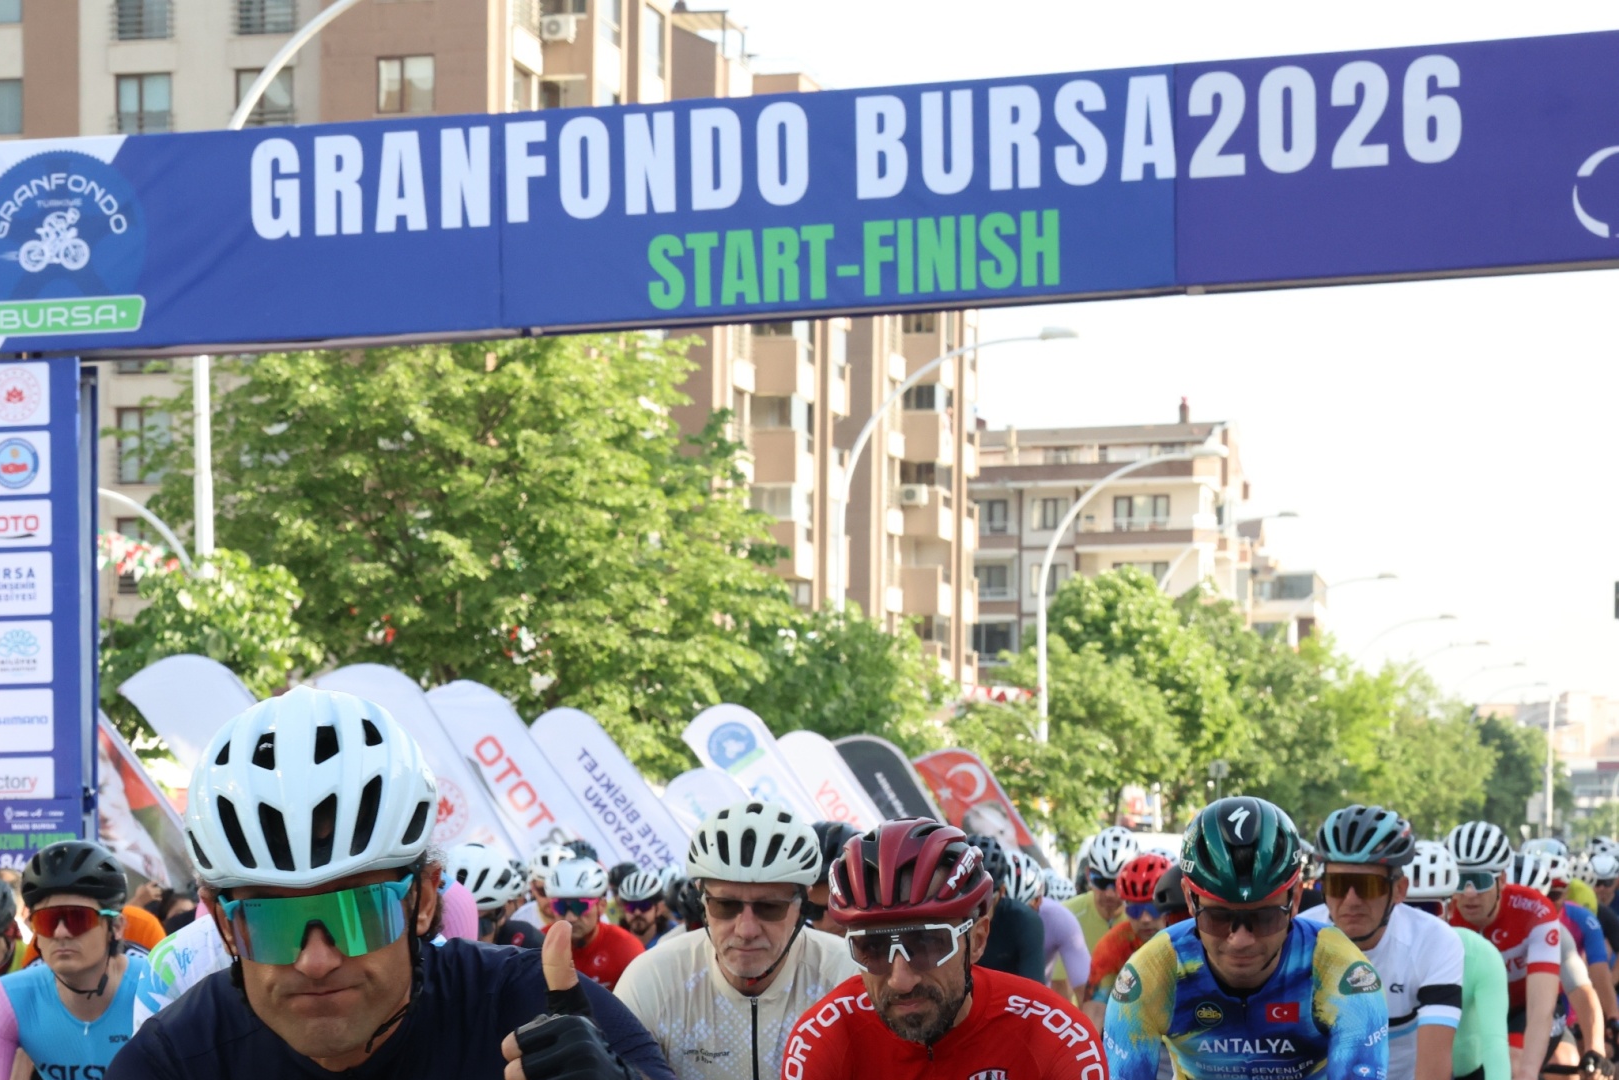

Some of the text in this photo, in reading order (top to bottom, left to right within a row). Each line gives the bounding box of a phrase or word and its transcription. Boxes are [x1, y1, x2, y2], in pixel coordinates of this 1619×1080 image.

[251, 101, 809, 240] GRANFONDO
[648, 208, 1060, 310] START-FINISH
[0, 304, 117, 330] BURSA
[1197, 1038, 1296, 1054] ANTALYA
[1195, 1059, 1314, 1075] BİSİKLET SEVENLER
